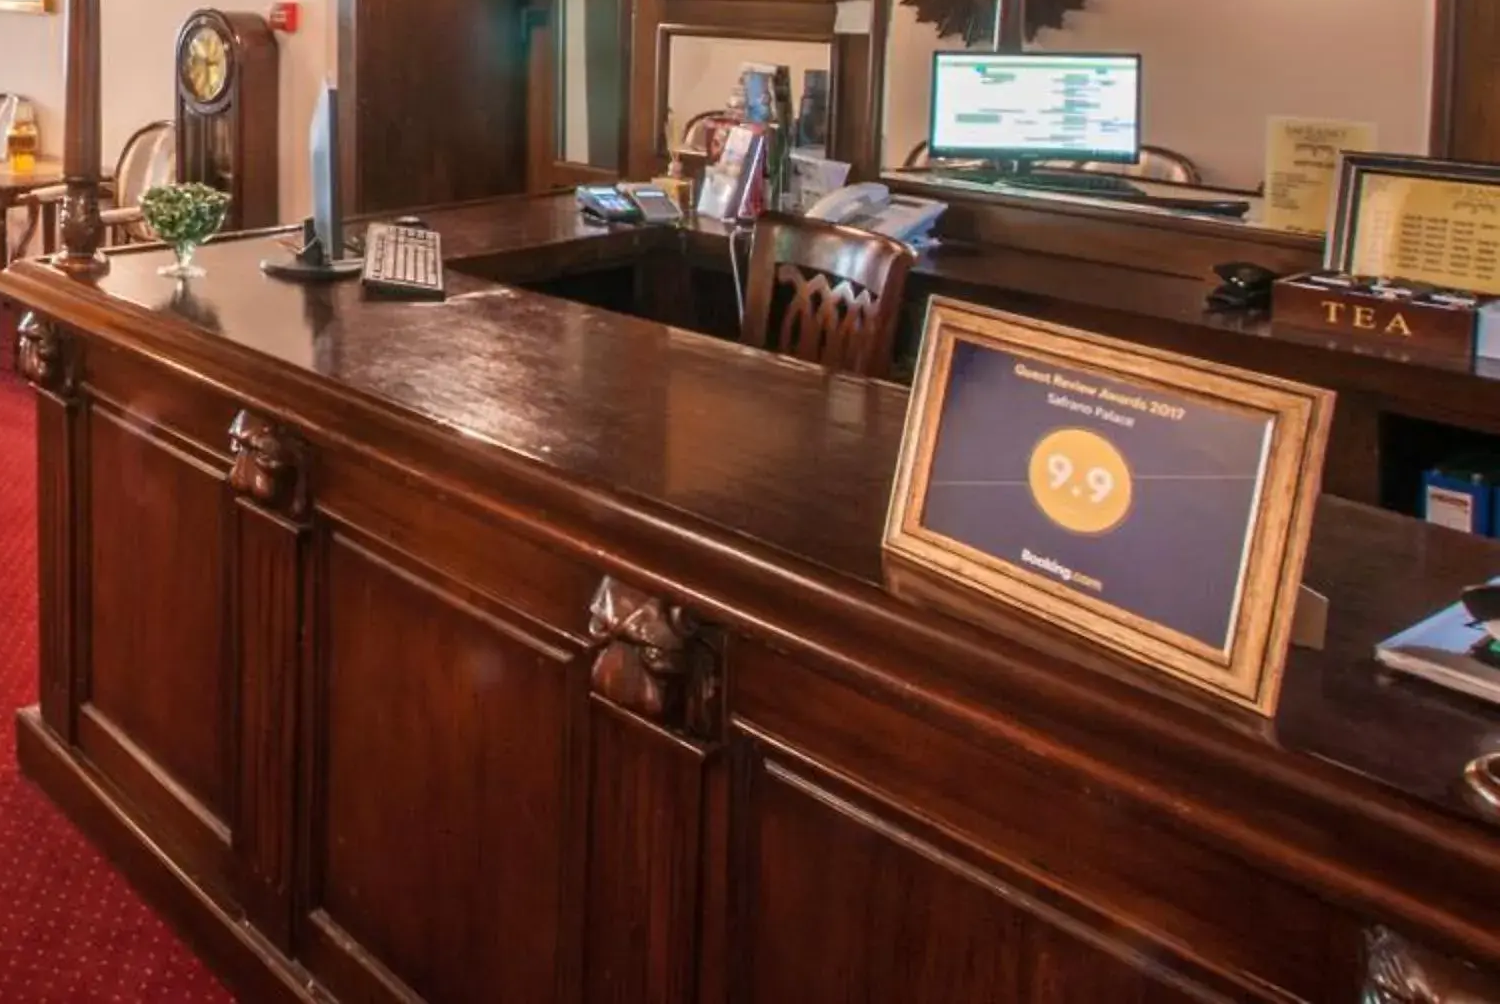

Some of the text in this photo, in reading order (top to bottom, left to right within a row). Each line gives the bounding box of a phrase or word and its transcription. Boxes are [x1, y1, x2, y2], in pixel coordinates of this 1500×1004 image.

[1320, 300, 1413, 337] TEA
[1013, 363, 1187, 421] Guest Review Awards 2017
[1094, 406, 1136, 429] Palace
[1047, 453, 1115, 504] 9.9
[1021, 547, 1104, 593] Booking.com
